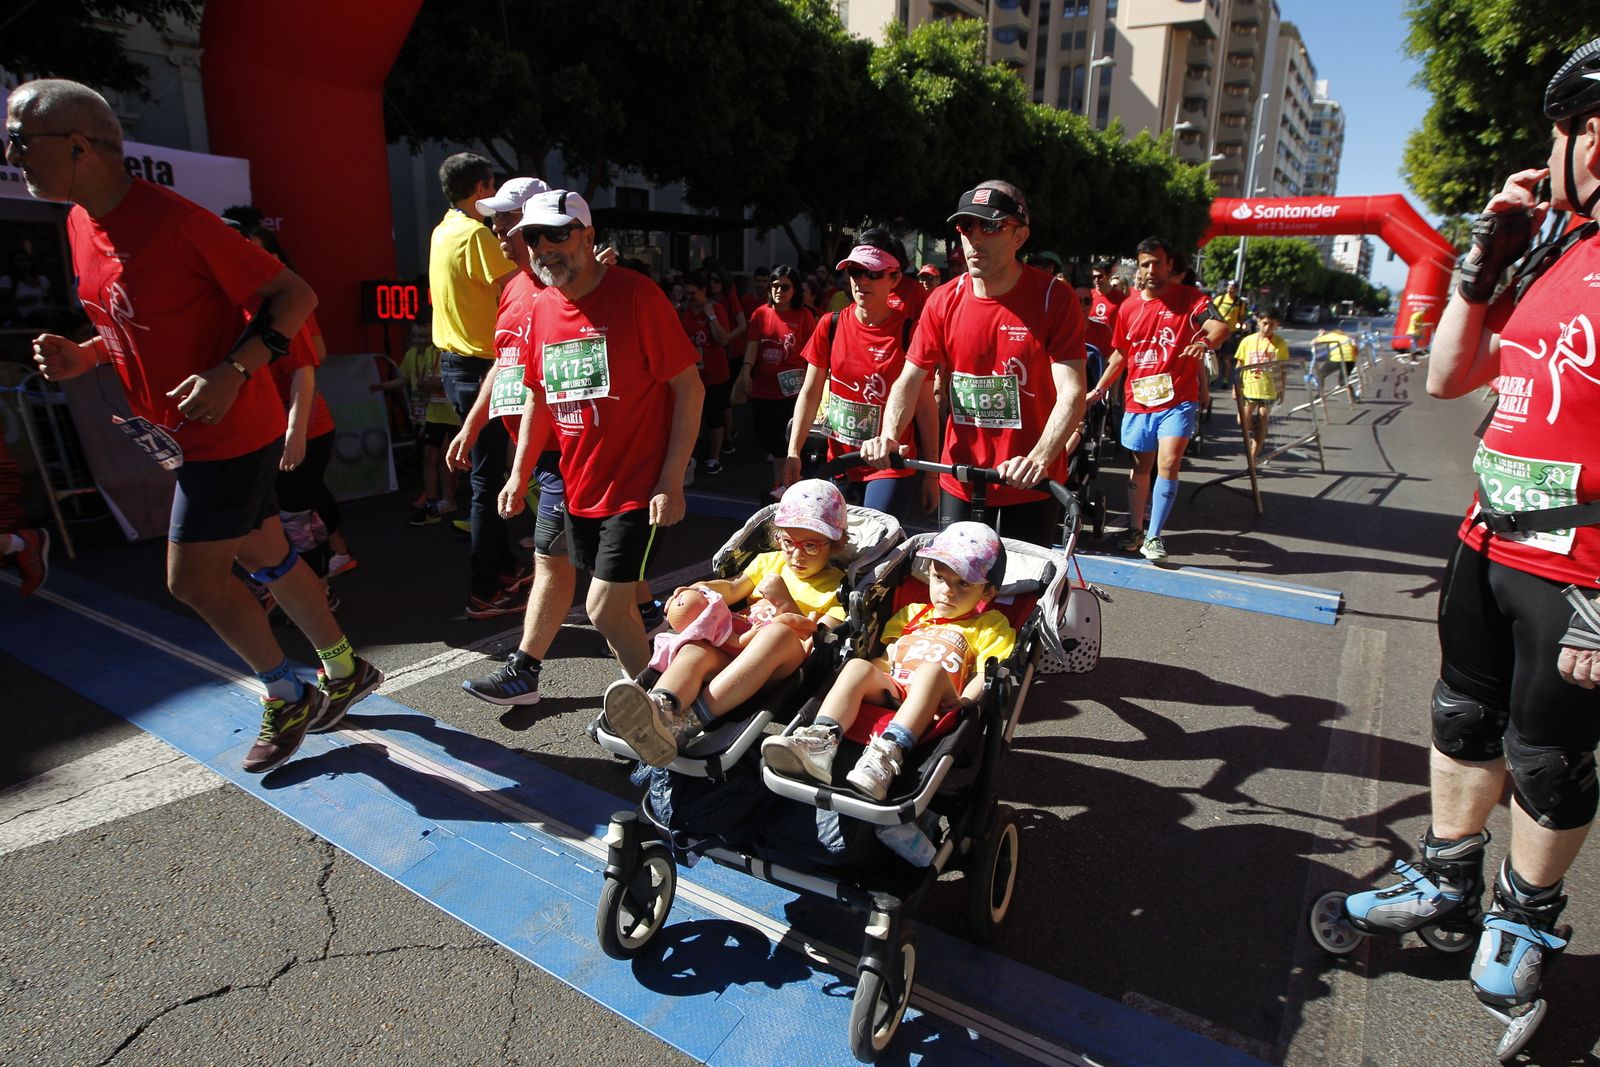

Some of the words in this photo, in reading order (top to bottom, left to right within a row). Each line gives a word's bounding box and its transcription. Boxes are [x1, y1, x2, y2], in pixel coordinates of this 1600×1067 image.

[1253, 203, 1340, 219] Santander
[548, 357, 595, 381] 1175
[493, 381, 524, 400] 1219
[783, 376, 804, 387] 105
[957, 391, 1006, 410] 1183
[832, 409, 868, 432] 1184
[902, 640, 963, 673] 235
